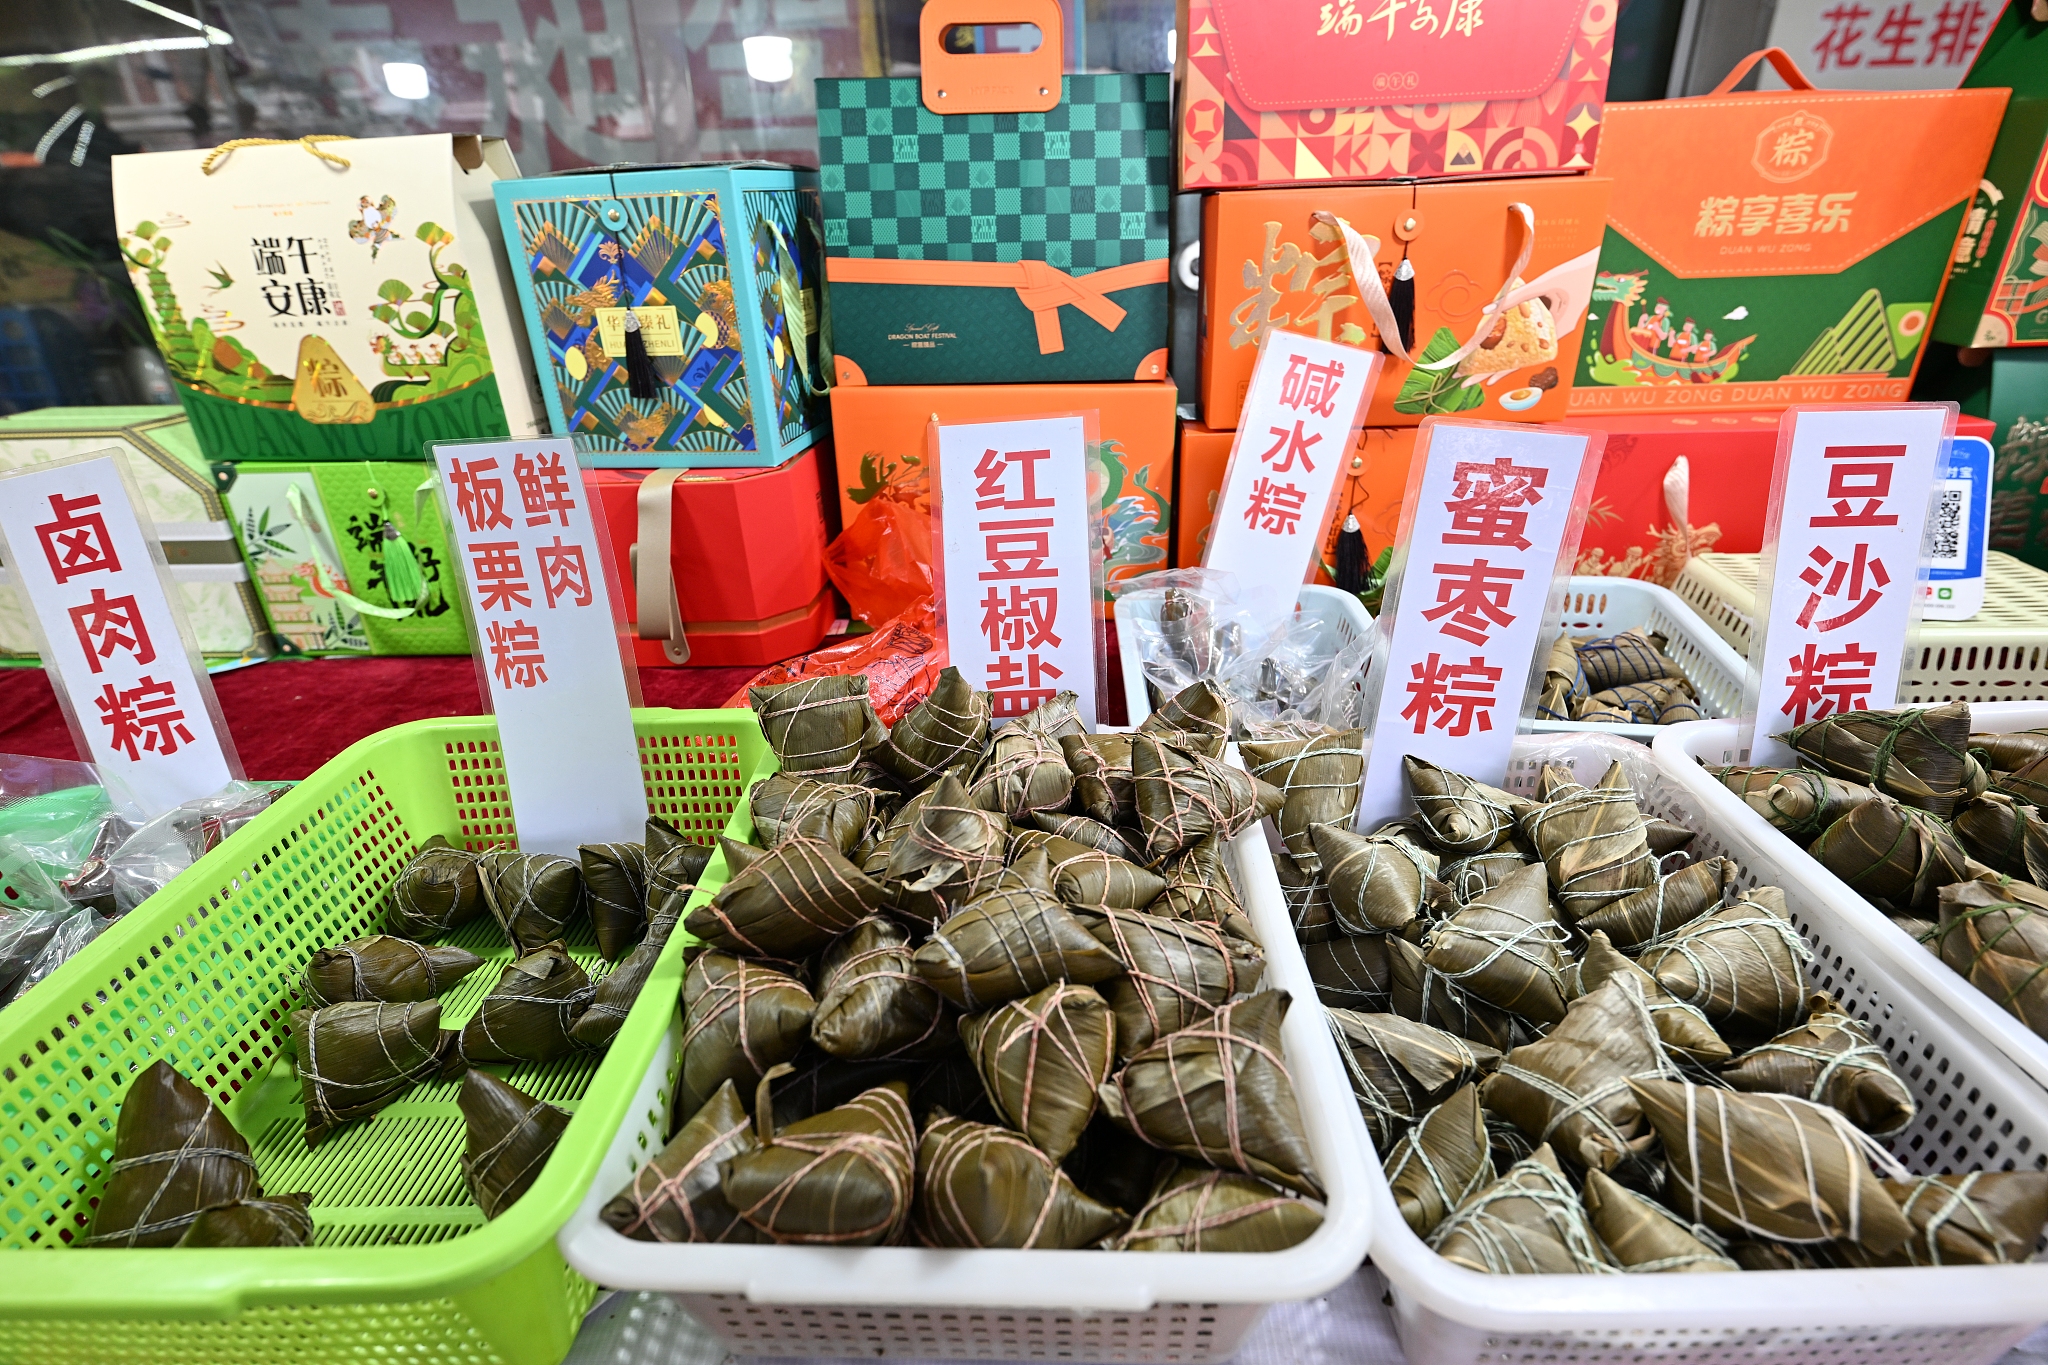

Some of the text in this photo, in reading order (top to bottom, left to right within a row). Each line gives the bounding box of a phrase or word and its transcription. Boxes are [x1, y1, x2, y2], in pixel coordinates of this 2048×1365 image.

[1813, 1, 1986, 71] 花生排
[1768, 128, 1815, 167] 粽
[1693, 191, 1859, 238] 粽享喜乐
[1719, 244, 1812, 255] DUAN WU ZONG
[250, 236, 318, 275] 端午
[261, 277, 332, 317] 安康
[606, 314, 671, 332] 华臻礼
[1570, 383, 1903, 407] UAN WU ZONG DUAN WU ZONG
[1243, 354, 1345, 536] 碱水粽
[511, 451, 593, 611] 鲜肉
[448, 456, 549, 690] 板栗粽
[973, 448, 1065, 718] 红豆椒盐
[1400, 457, 1549, 737] 蜜枣粽
[1780, 444, 1907, 728] 豆沙粽
[34, 493, 197, 762] 卤肉粽
